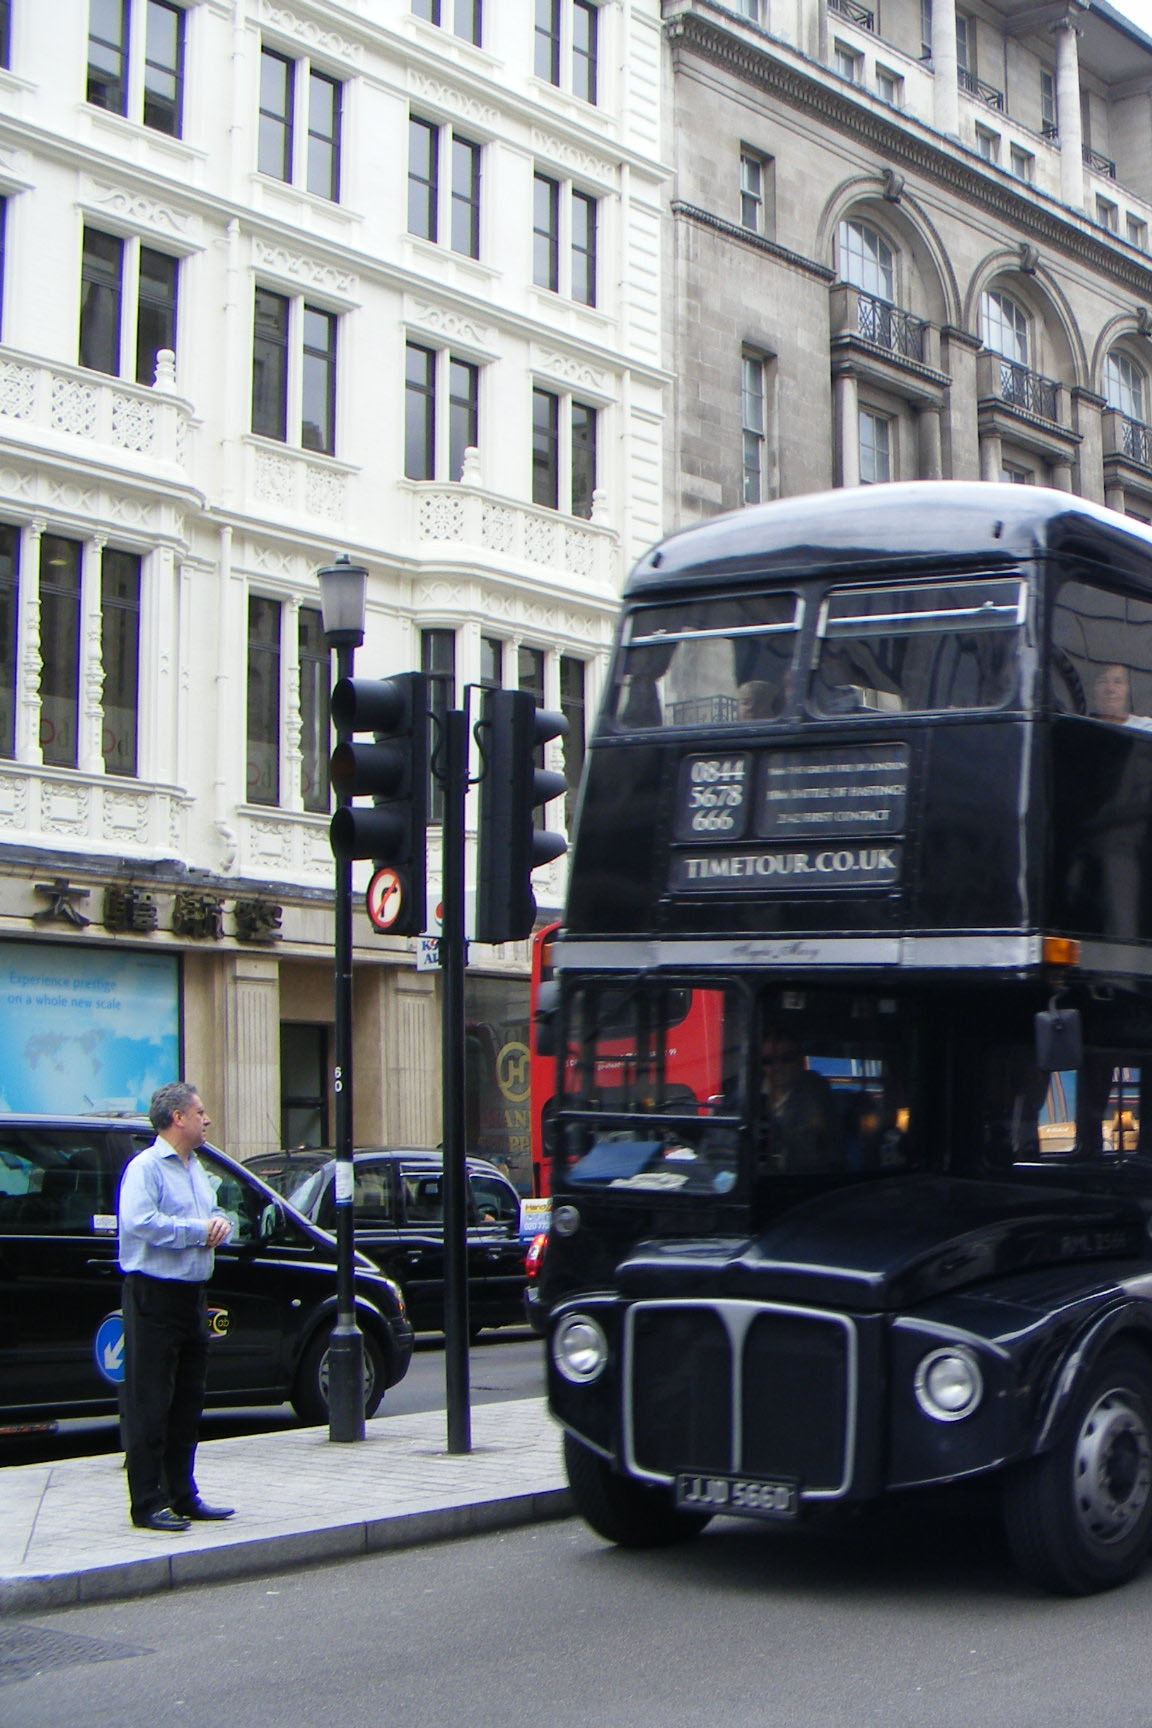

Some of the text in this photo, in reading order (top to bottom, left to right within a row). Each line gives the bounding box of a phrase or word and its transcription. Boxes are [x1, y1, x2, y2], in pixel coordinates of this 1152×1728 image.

[691, 760, 745, 782] 0844
[689, 784, 743, 808] 5678
[692, 808, 735, 831] 666
[684, 849, 896, 879] TIMETOUR.CO.UK
[8, 970, 117, 993] Experience prestige
[8, 992, 122, 1011] on a whole new scale
